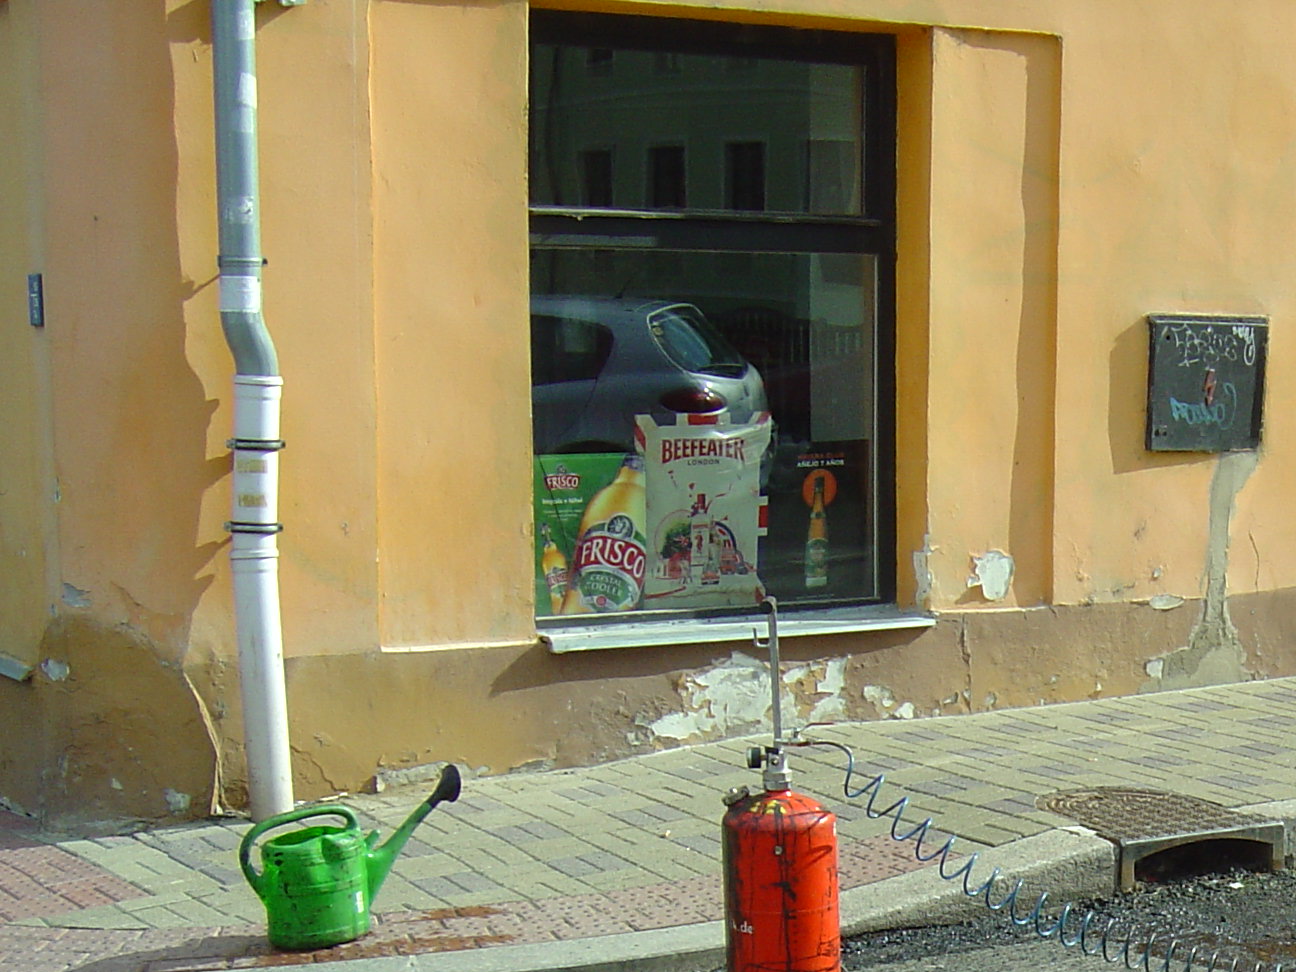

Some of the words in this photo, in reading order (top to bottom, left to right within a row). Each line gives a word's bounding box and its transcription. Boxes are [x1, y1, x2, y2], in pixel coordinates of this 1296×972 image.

[662, 437, 746, 464] BEEFEATER
[687, 458, 720, 466] LONDON
[546, 476, 579, 488] FRISCO
[581, 538, 645, 579] FRISCO
